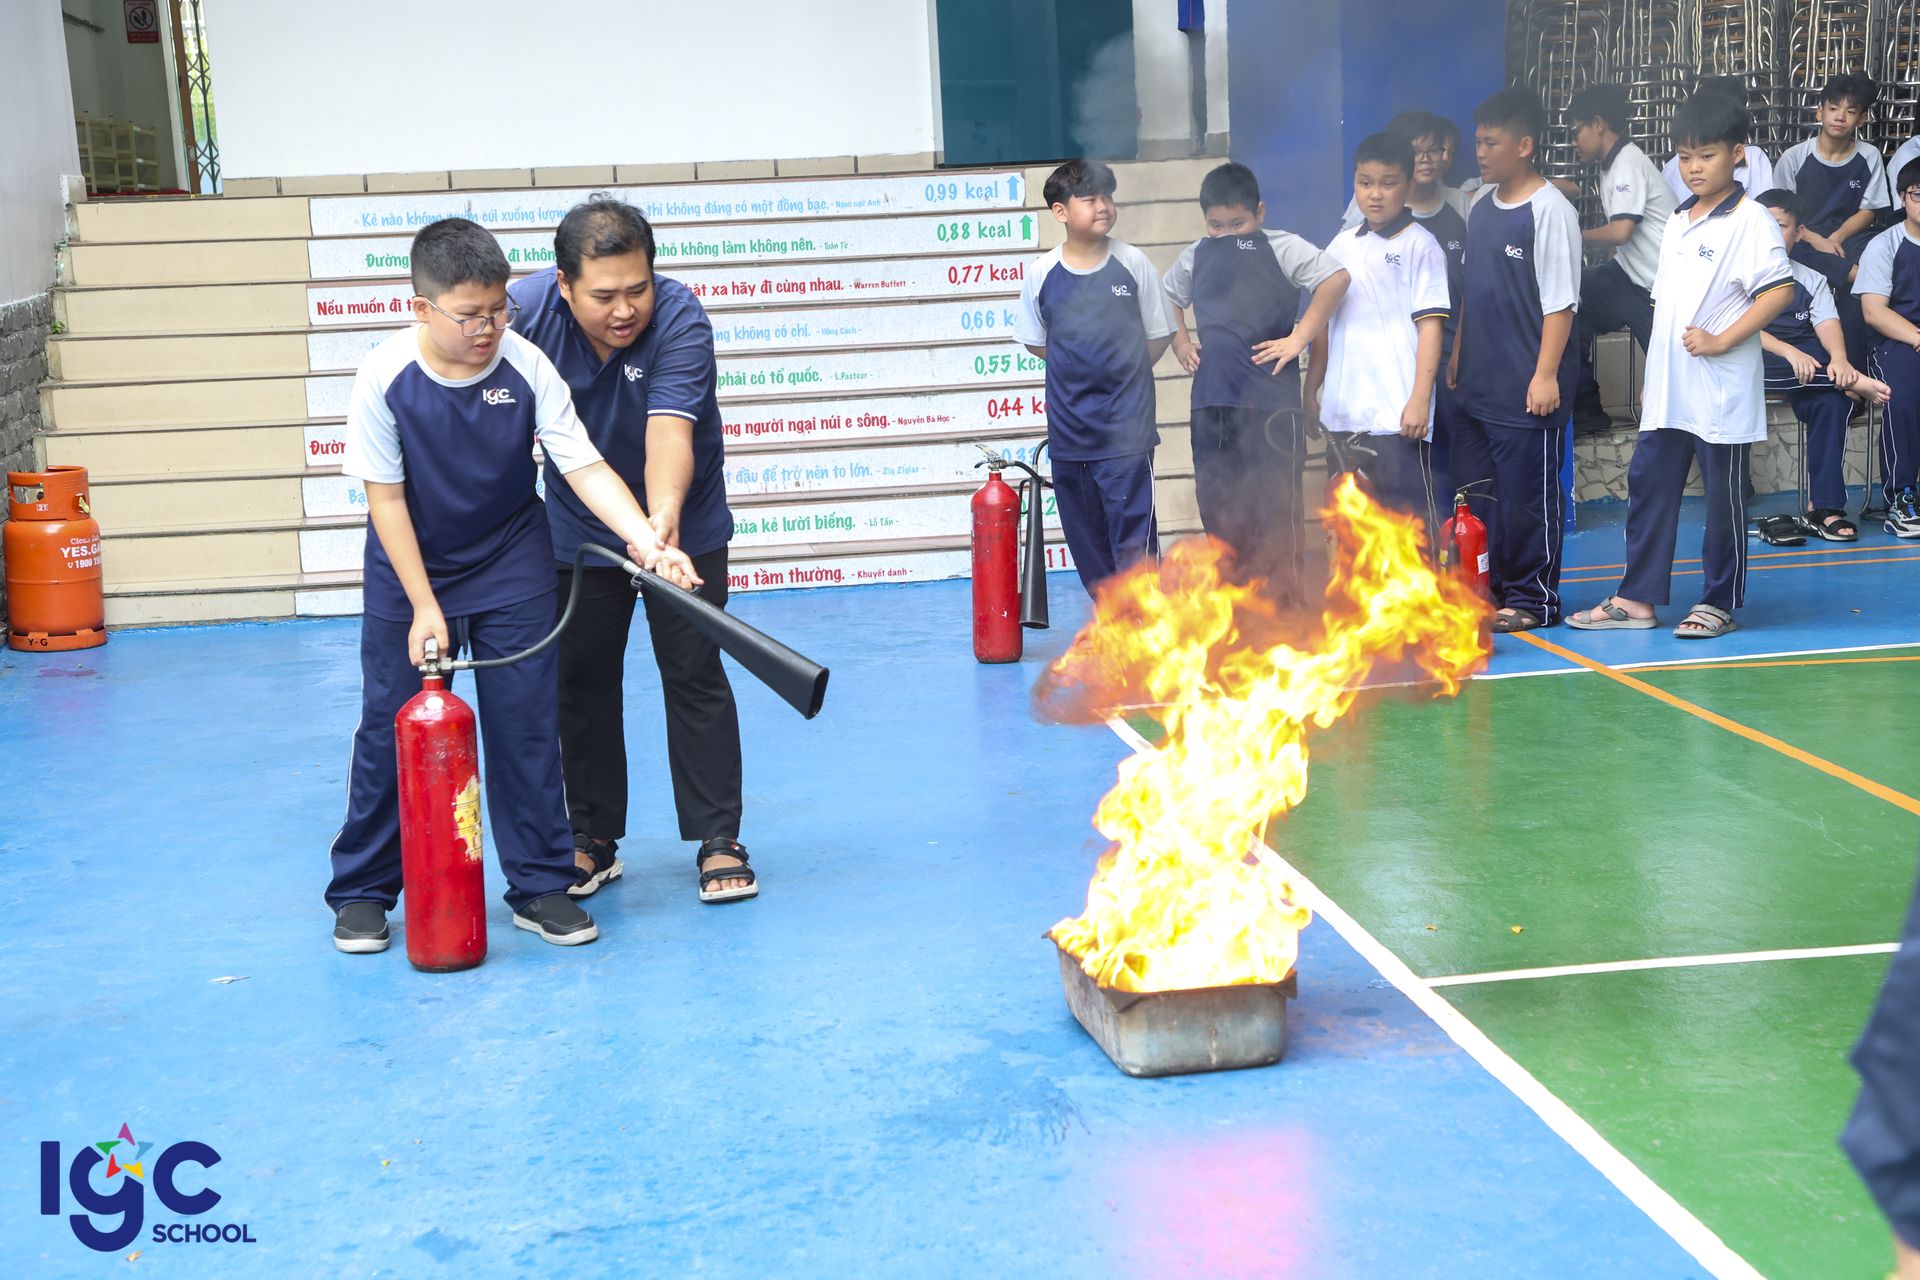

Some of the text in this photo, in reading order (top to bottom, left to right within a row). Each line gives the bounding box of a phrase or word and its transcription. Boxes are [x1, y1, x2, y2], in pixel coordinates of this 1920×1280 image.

[925, 180, 998, 203] 0,99 kcal
[361, 211, 379, 228] Kẻ
[381, 209, 404, 226] nào
[482, 207, 499, 223] cúi
[501, 206, 536, 224] xuống
[647, 201, 663, 217] thì
[666, 201, 701, 218] không
[704, 200, 732, 216] đáng
[735, 199, 748, 213] có
[751, 199, 773, 215] một
[777, 196, 804, 214] đồng
[937, 219, 1012, 243] 0,88 kcal
[508, 247, 520, 263] đi
[681, 241, 719, 257] không
[723, 240, 747, 255] làm
[750, 238, 788, 254] không
[791, 236, 817, 252] nên.
[365, 252, 410, 269] Đường
[948, 261, 1024, 285] 0,77 kcal
[712, 284, 728, 297] xa
[731, 281, 757, 297] hãy
[761, 279, 772, 294] đi
[776, 279, 806, 295] cùng
[810, 277, 844, 292] nhau.
[854, 281, 880, 290] Warren
[881, 280, 906, 289] Buffett
[317, 299, 344, 316] Nếu
[347, 297, 385, 315] muốn
[389, 297, 402, 313] đi
[961, 310, 995, 331] 0,66
[734, 326, 771, 341] không
[774, 324, 788, 338] có
[974, 354, 1012, 376] 0,55
[717, 371, 747, 390] phải
[750, 370, 766, 385] có
[770, 367, 785, 384] tổ
[788, 366, 822, 386] quốc.
[987, 397, 1024, 420] 0,44
[745, 418, 784, 436] người
[788, 416, 817, 434] ngại
[820, 414, 841, 430] núi
[845, 416, 853, 428] e
[856, 412, 891, 429] sông.
[736, 466, 759, 484] đầu
[762, 464, 778, 482] để
[781, 465, 802, 481] trở
[806, 464, 829, 479] nên
[833, 464, 846, 479] to
[850, 462, 873, 478] lớn.
[733, 518, 758, 535] của
[761, 517, 779, 533] kẻ
[783, 515, 811, 532] lười
[815, 511, 856, 531] biếng.
[75, 558, 93, 569] 1900
[754, 568, 784, 585] tầm
[788, 566, 845, 583] thường.
[887, 566, 908, 577] danh
